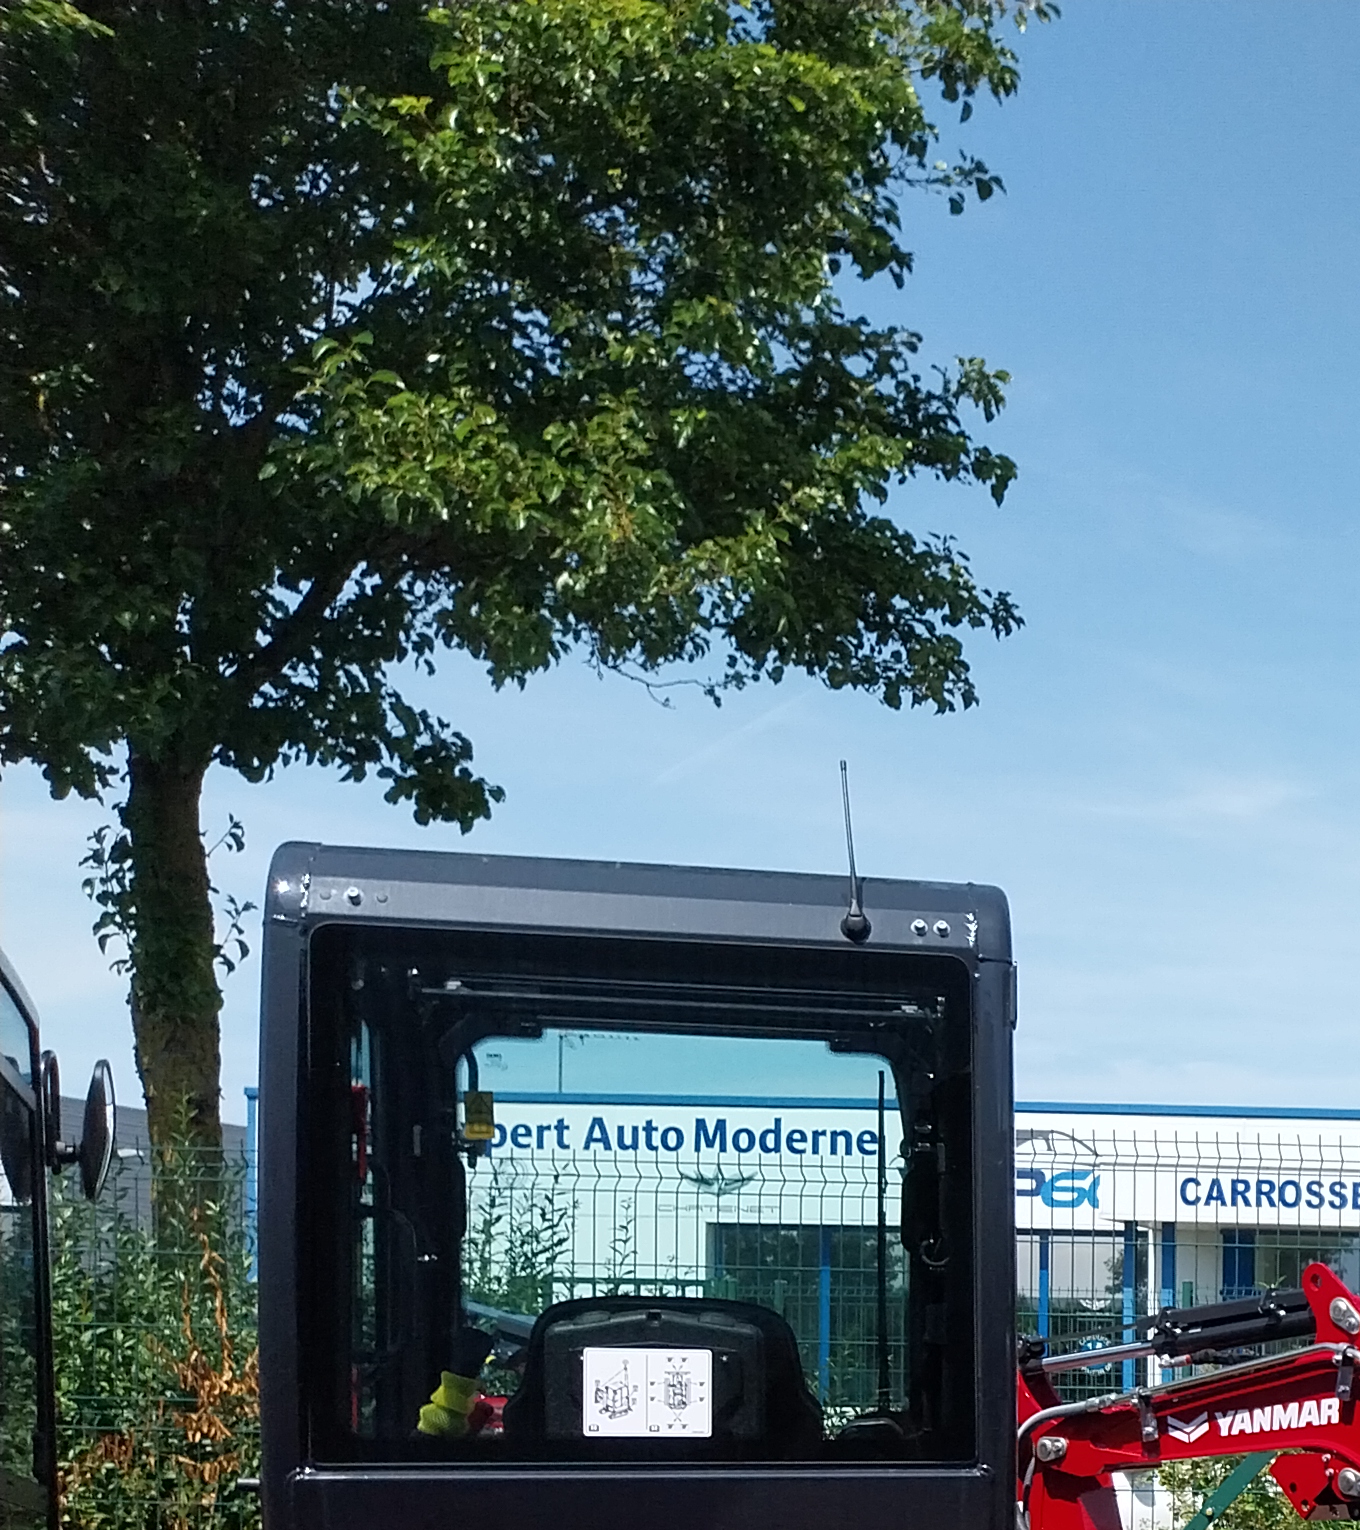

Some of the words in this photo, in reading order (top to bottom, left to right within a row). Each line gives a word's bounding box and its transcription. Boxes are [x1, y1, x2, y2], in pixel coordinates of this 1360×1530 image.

[485, 1117, 570, 1158] pert
[583, 1117, 685, 1151] Auto
[694, 1117, 879, 1156] Moderne
[1214, 1397, 1340, 1437] YANMAR
